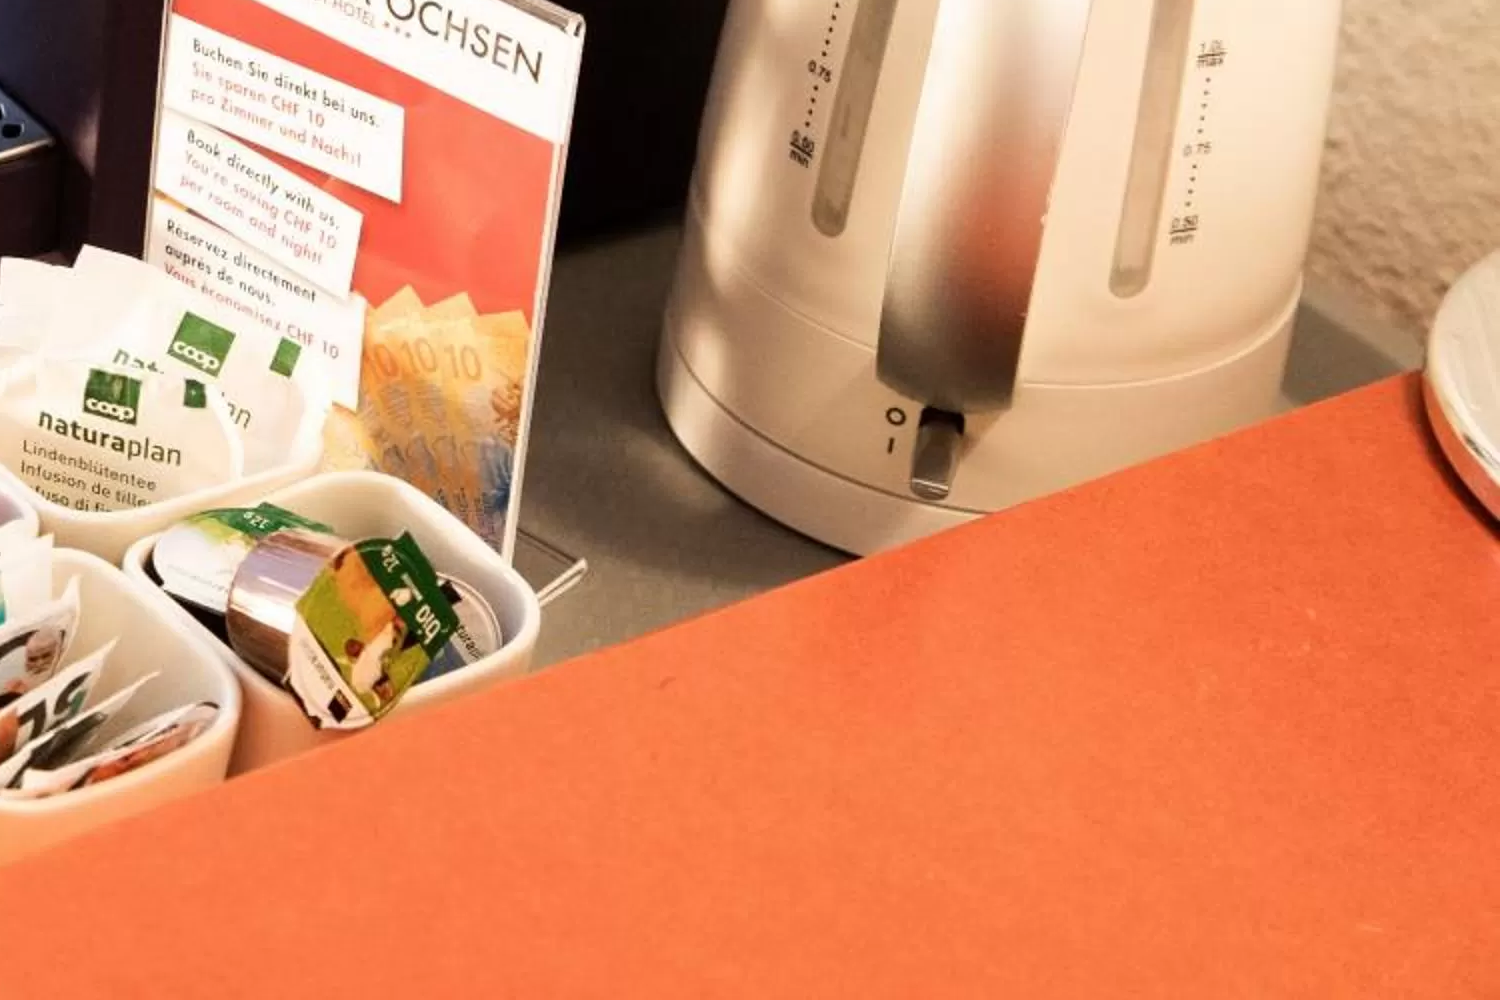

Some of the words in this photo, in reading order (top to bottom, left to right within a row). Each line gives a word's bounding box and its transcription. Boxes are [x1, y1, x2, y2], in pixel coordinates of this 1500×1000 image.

[192, 61, 213, 81] Sie
[218, 77, 267, 102] sparen
[271, 95, 300, 117] CHF
[307, 109, 325, 128] 10
[193, 38, 244, 71] Buchen
[247, 62, 269, 81] Sie
[274, 73, 318, 101] direkt
[322, 90, 345, 113] bei
[350, 107, 381, 128] uns.
[807, 59, 833, 85] 0.75
[191, 88, 215, 105] pro
[221, 97, 274, 129] Zimmer
[279, 122, 307, 145] und
[187, 128, 221, 158] Book
[227, 154, 280, 195] directly
[285, 188, 315, 215] with
[180, 174, 204, 193] per
[208, 191, 245, 218] room
[249, 214, 276, 239] and
[184, 151, 229, 187] You're
[233, 183, 280, 221] saving
[283, 209, 313, 234] CHF
[318, 229, 338, 249] 10
[217, 266, 235, 286] de
[239, 279, 276, 306] nous.
[233, 251, 317, 304] directement
[163, 261, 198, 289] Vous
[286, 324, 315, 347] CHF
[322, 339, 340, 360] 10
[173, 340, 220, 371] coop
[444, 343, 483, 381] 10
[86, 398, 136, 423] coop
[22, 439, 158, 491] Lindenblütentee
[38, 411, 182, 466] naturaplan
[20, 459, 88, 491] Infusion
[91, 483, 112, 499] de
